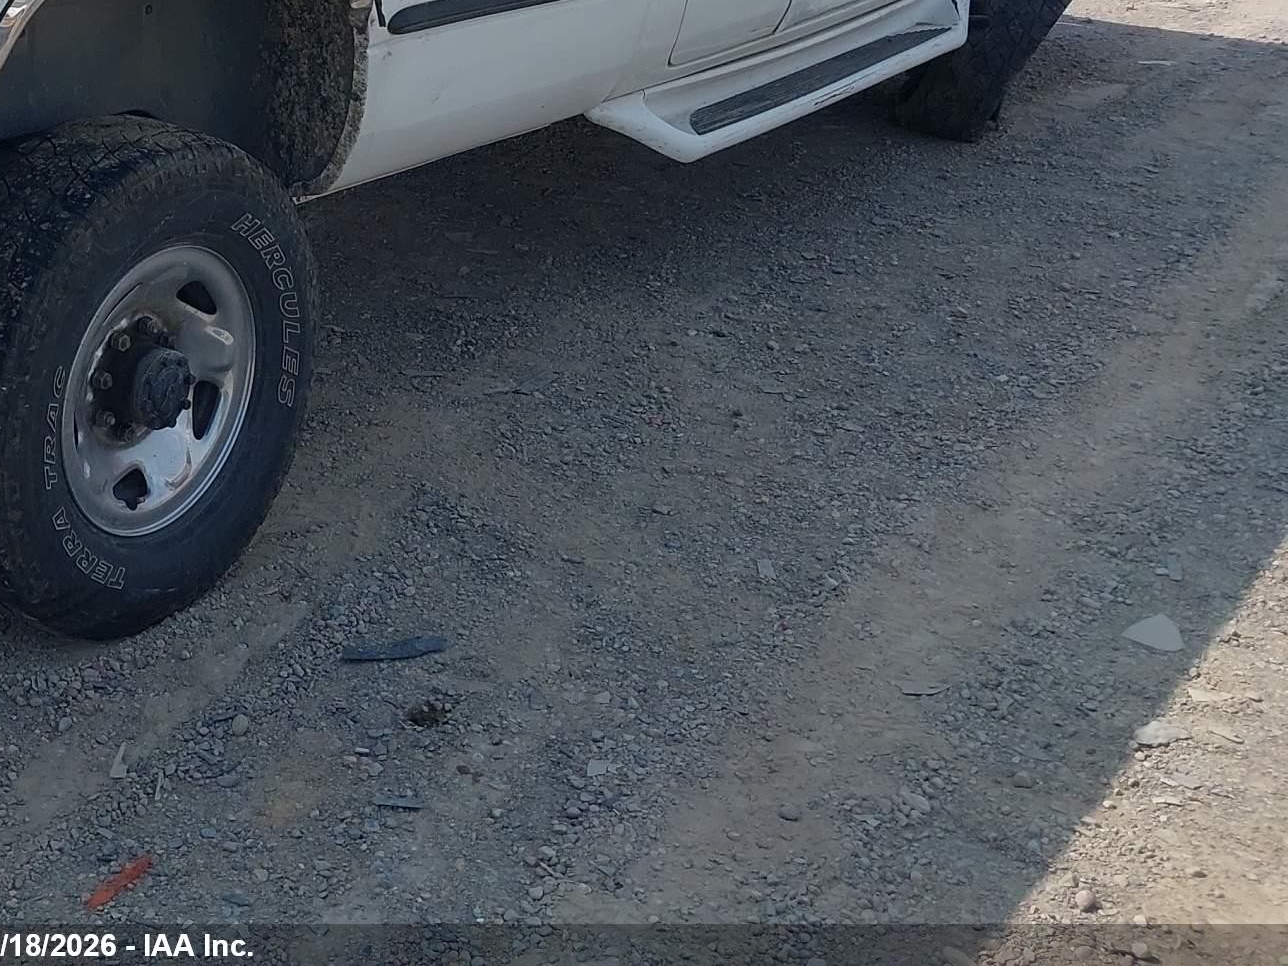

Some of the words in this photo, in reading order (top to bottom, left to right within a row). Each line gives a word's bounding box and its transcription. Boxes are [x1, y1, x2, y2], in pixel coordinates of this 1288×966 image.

[230, 212, 302, 408] HERCULES
[42, 364, 69, 490] TRAC
[50, 505, 127, 591] TERRA
